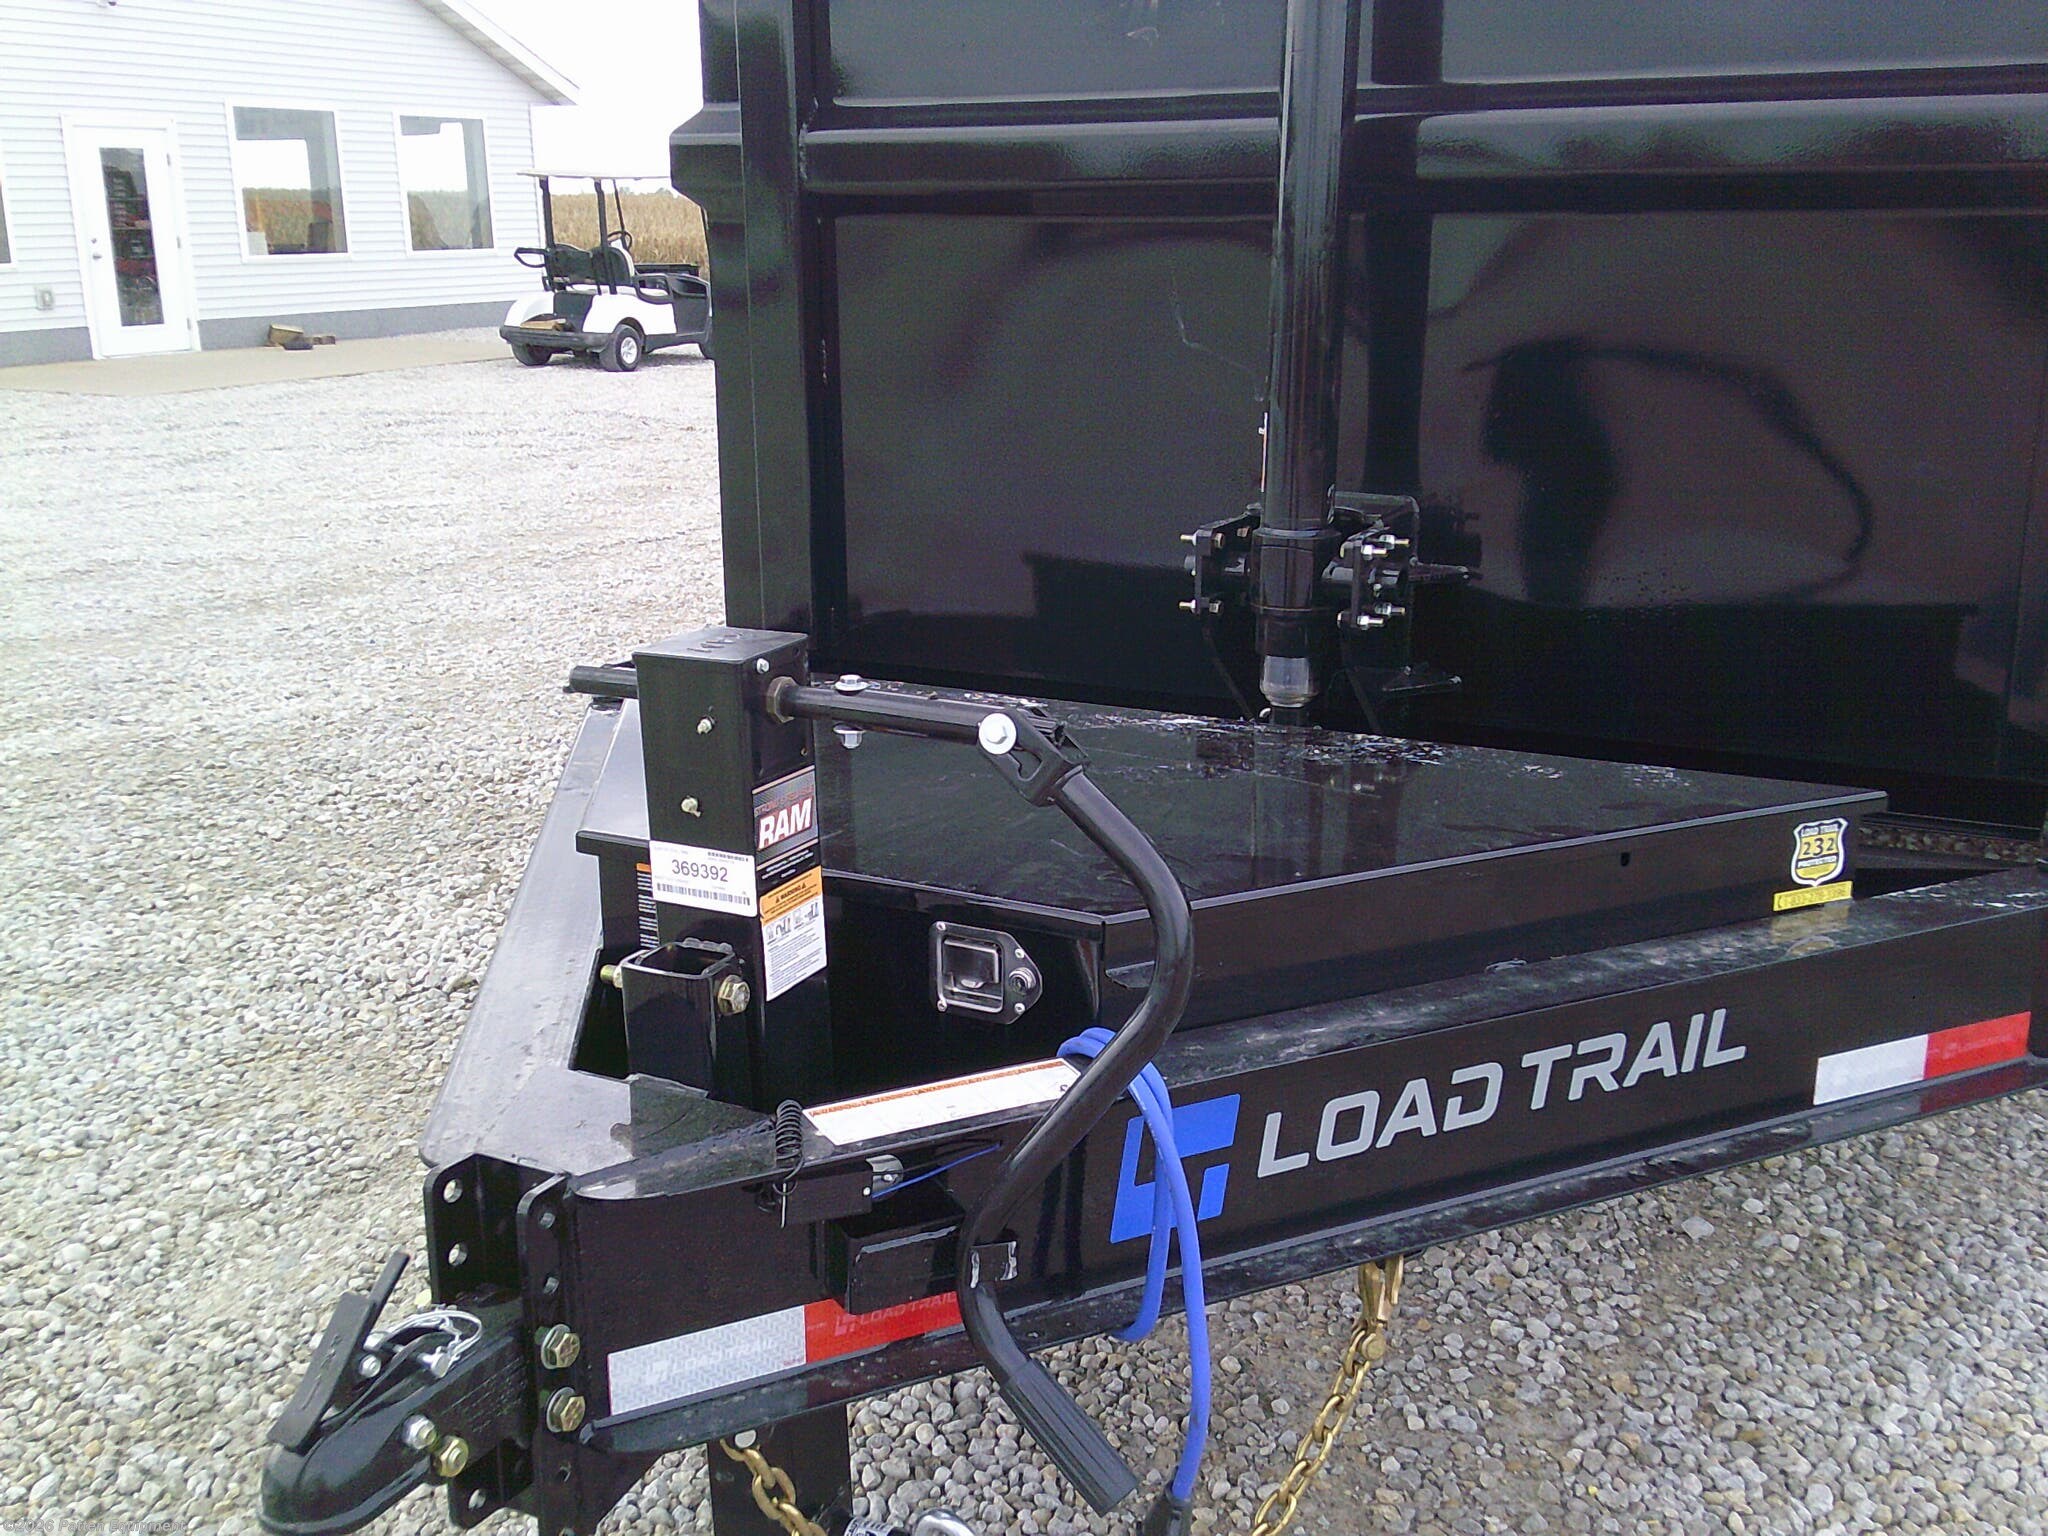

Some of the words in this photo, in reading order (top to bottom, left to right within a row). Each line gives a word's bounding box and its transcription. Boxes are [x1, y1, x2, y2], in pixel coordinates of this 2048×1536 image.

[757, 797, 813, 850] RAM
[1802, 837, 1834, 856] 232
[671, 859, 728, 882] 369392
[1257, 1062, 1502, 1178] LOAD
[1521, 1008, 1747, 1110] TRAIL
[860, 1303, 908, 1325] LOAD
